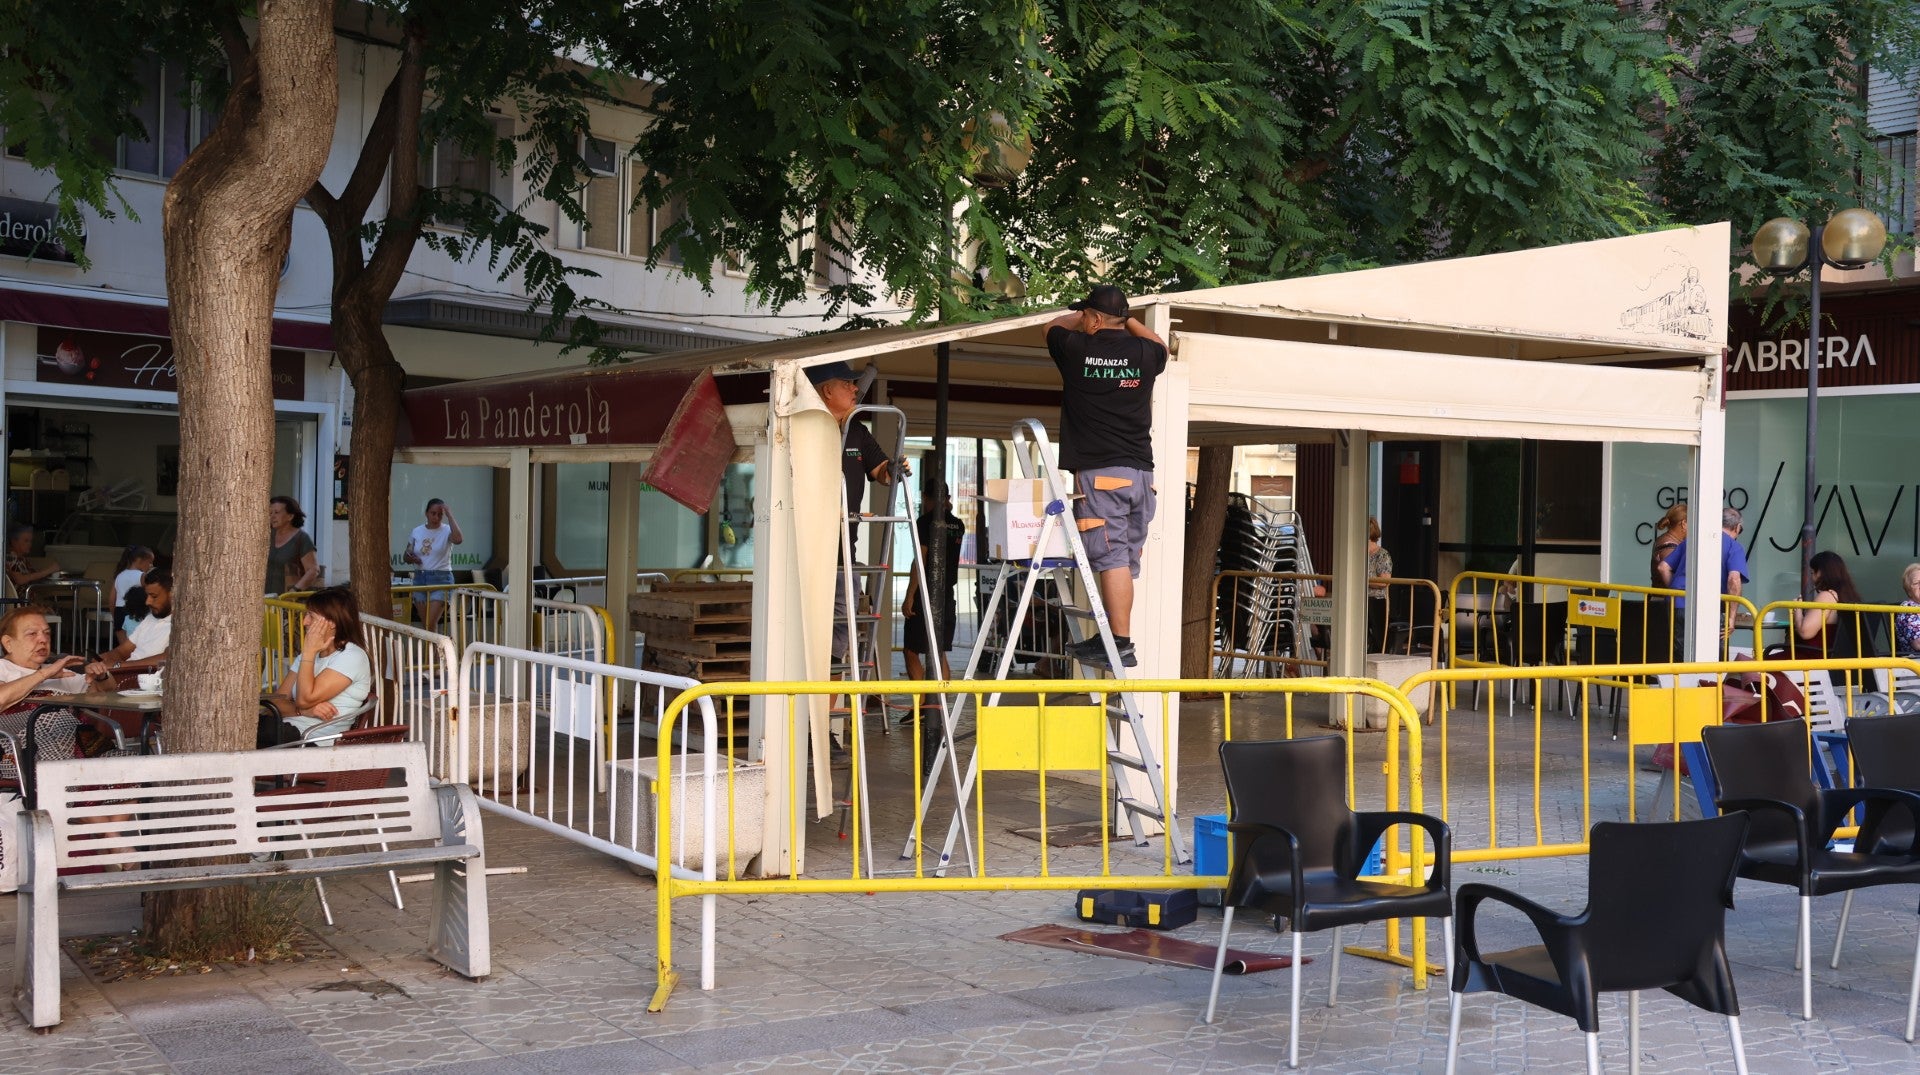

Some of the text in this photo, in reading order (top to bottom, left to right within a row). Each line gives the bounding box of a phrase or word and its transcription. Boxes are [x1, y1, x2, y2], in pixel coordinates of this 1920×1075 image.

[1085, 357, 1129, 367] MUDANZAS
[1083, 367, 1141, 379] LA PLANA
[1119, 379, 1140, 388] REUS
[444, 384, 612, 440] La Panderola
[1656, 486, 1749, 512] GRO
